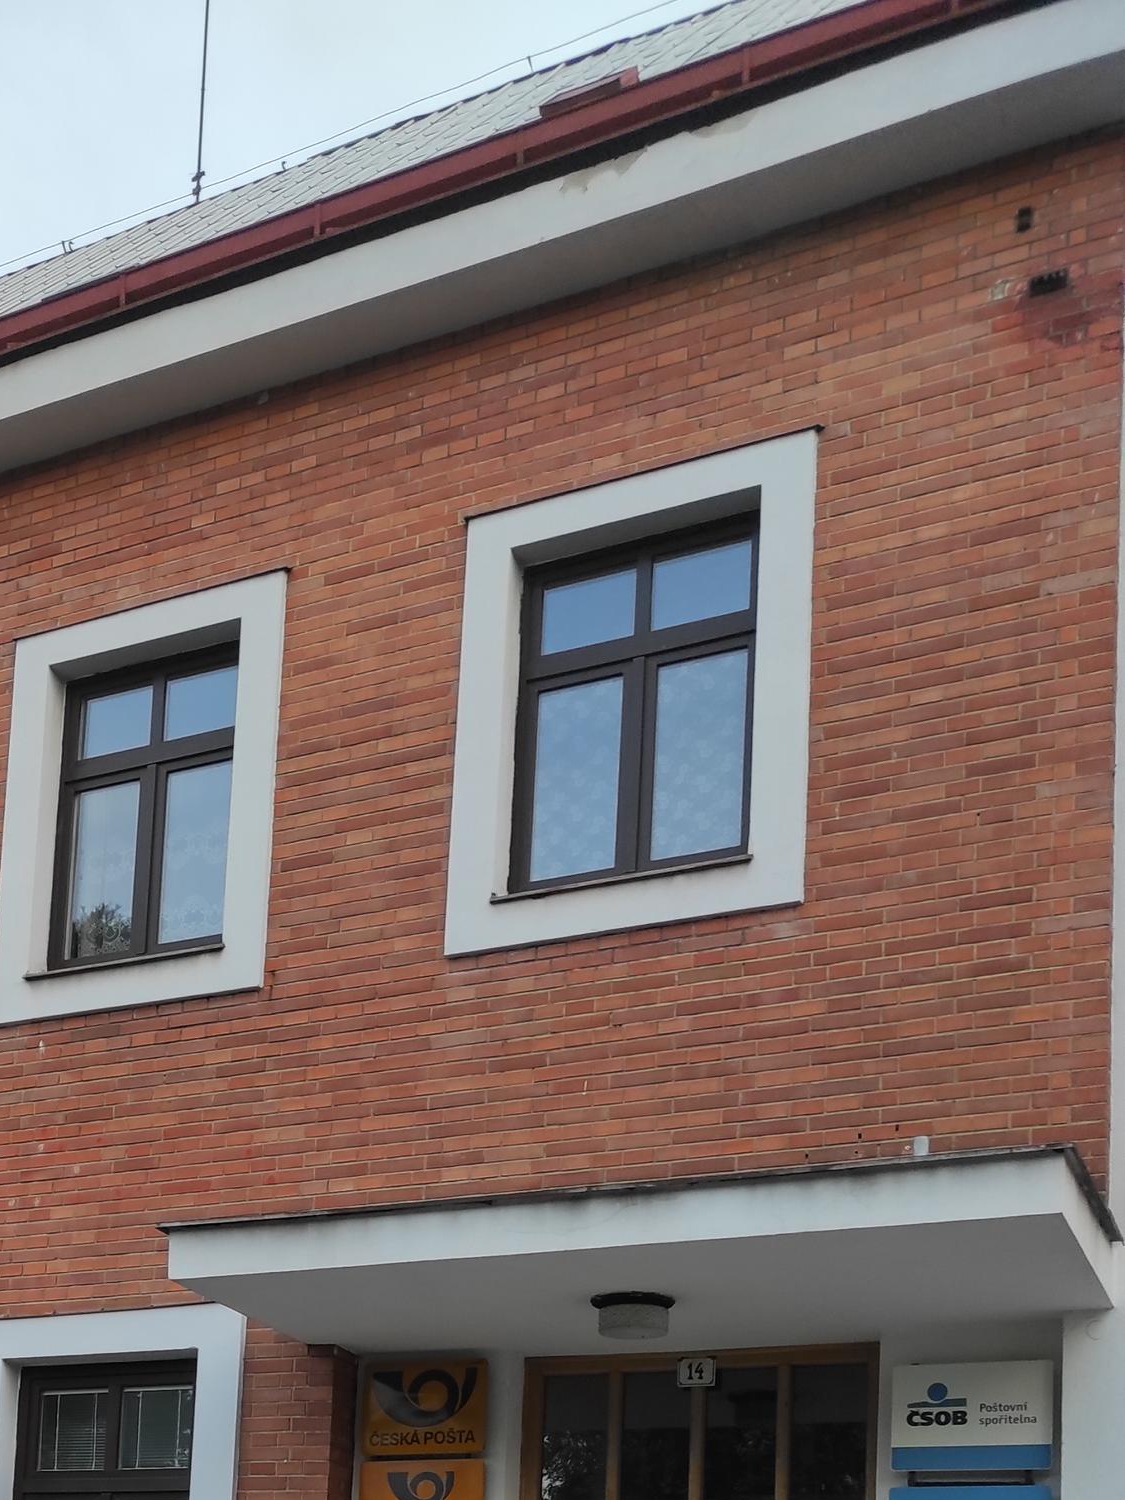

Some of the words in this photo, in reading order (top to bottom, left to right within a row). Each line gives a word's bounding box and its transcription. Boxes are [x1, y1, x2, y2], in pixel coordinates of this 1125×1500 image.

[687, 1361, 704, 1380] 14
[979, 1402, 1028, 1413] Poštovní
[906, 1410, 968, 1427] ČSOB
[979, 1414, 1037, 1427] spořitelna
[369, 1429, 420, 1447] ČESKÁ
[423, 1428, 476, 1445] POŠTA
